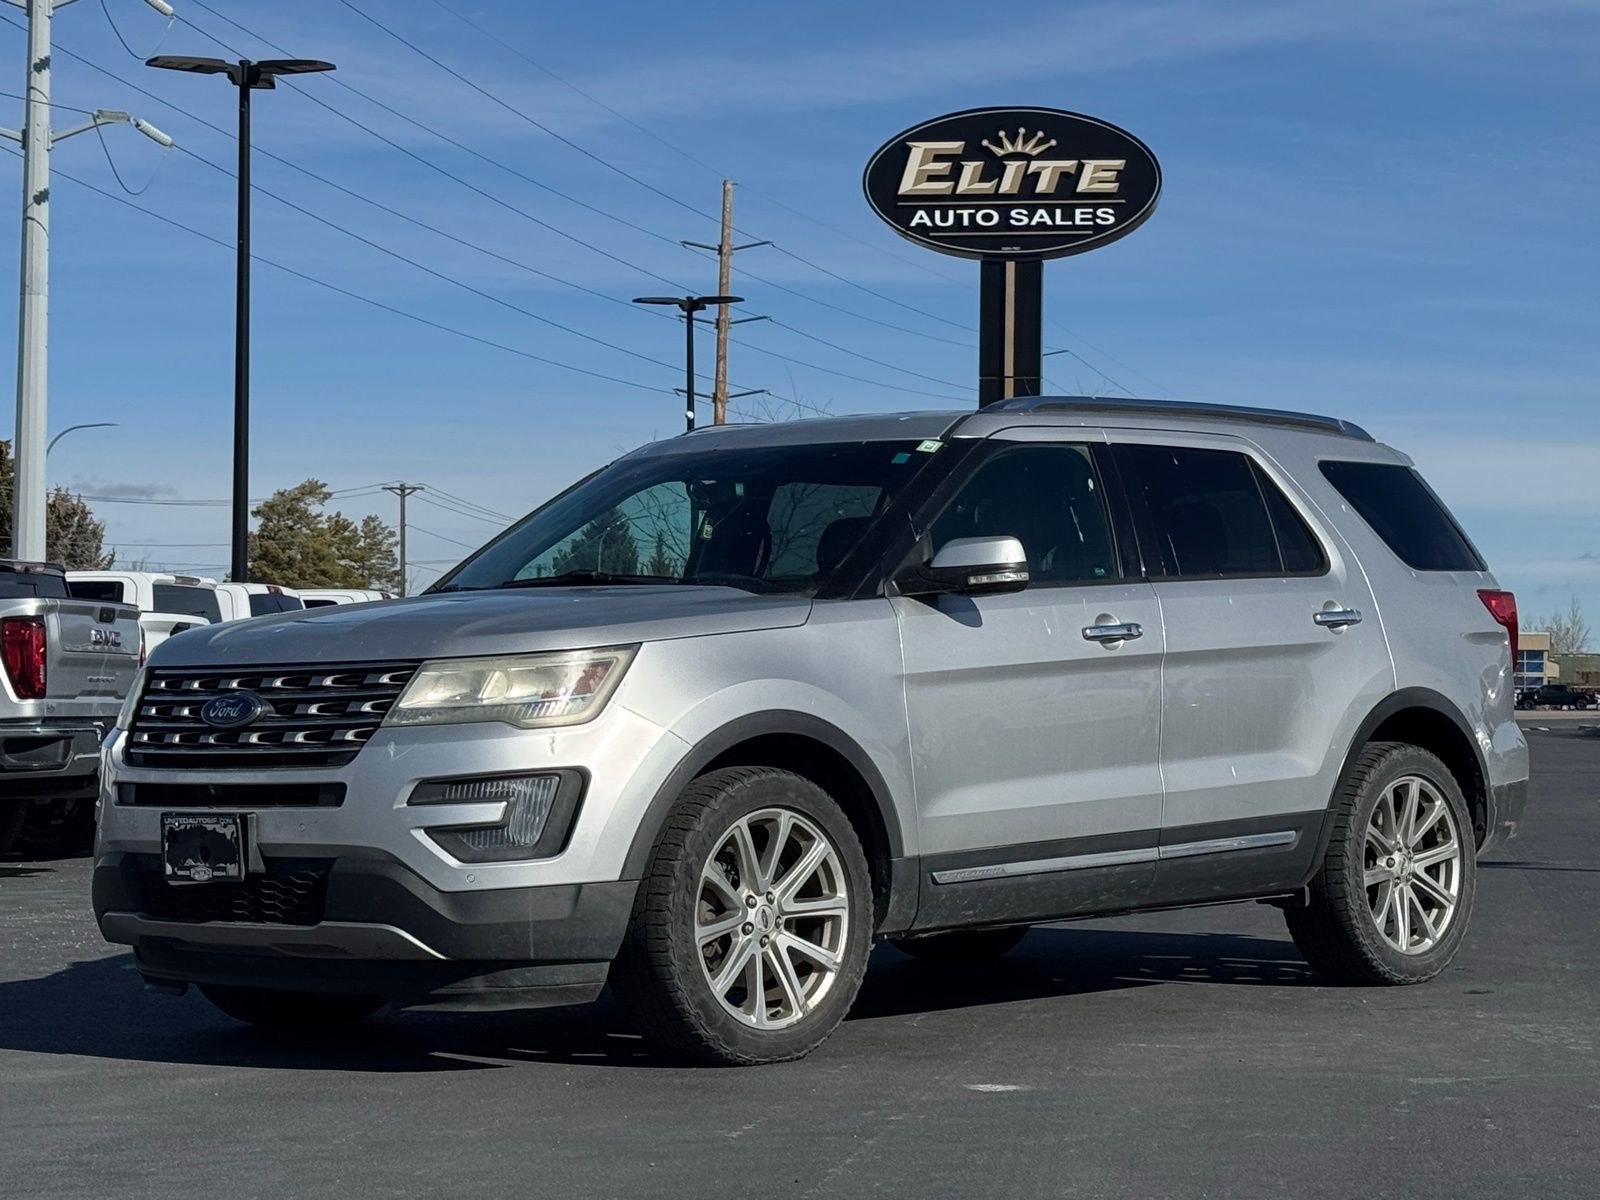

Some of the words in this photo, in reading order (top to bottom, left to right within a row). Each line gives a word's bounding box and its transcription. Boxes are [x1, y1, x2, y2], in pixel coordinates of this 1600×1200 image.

[909, 209, 1000, 227] AUTO
[1009, 208, 1116, 226] SALES
[208, 700, 244, 717] Ford
